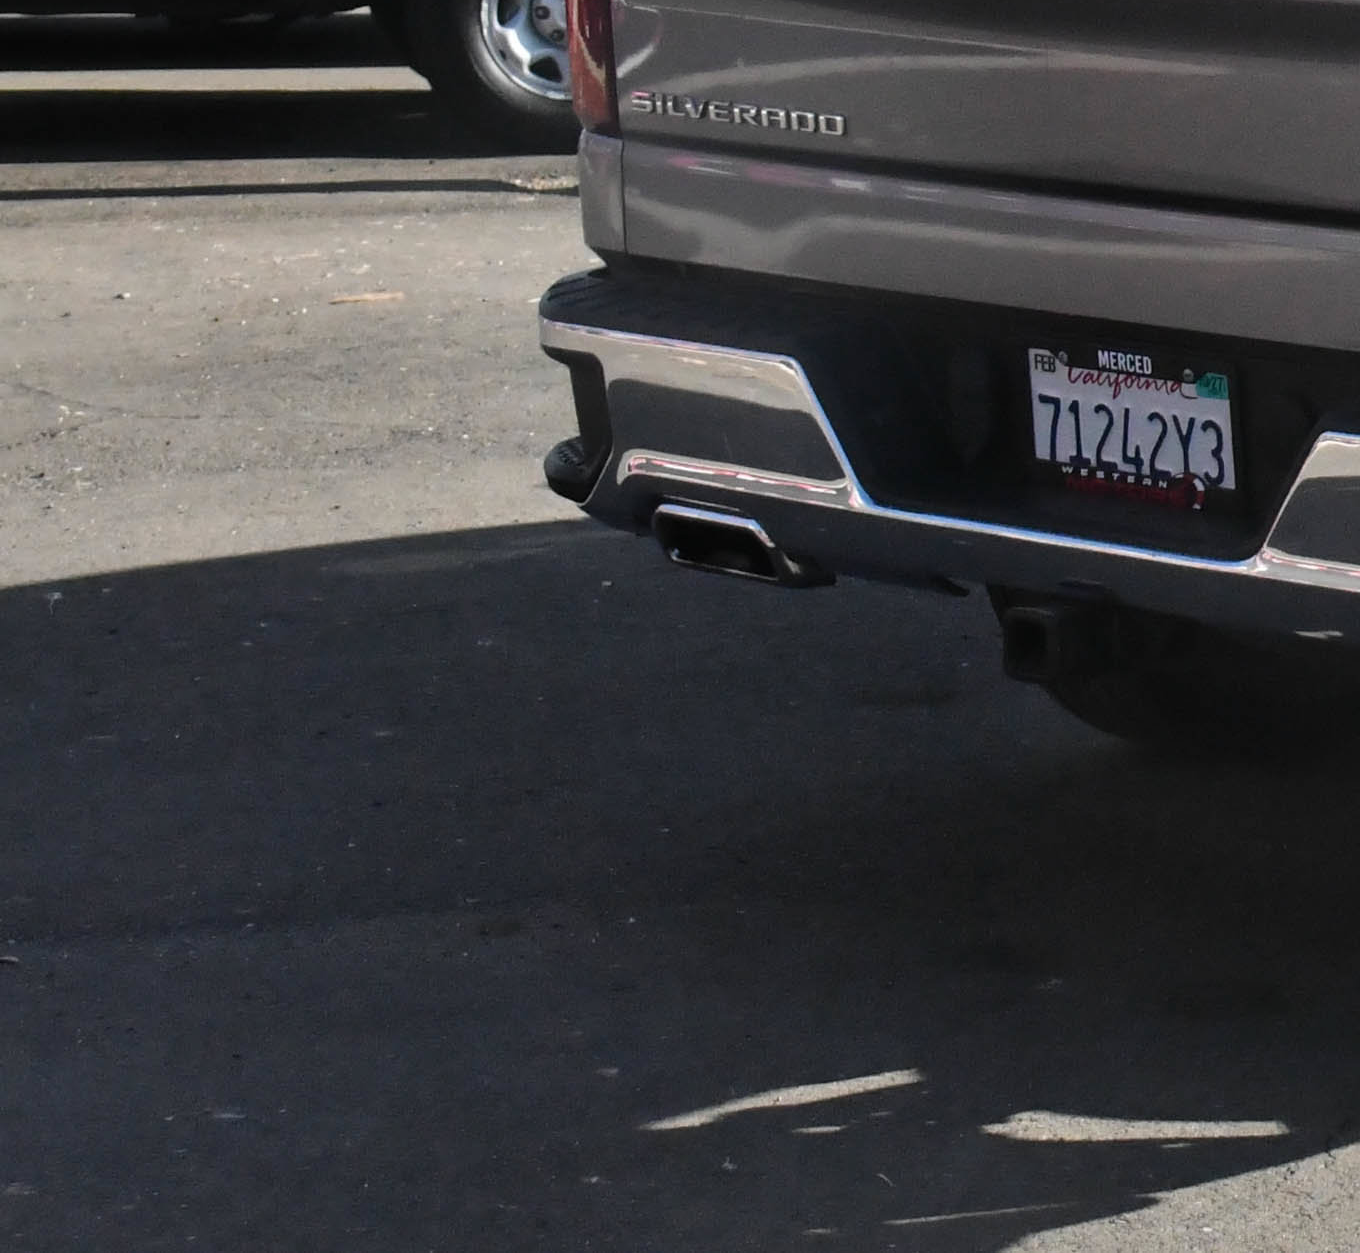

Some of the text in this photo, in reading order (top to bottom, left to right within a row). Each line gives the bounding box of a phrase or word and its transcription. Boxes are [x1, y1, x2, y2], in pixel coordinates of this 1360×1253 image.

[631, 91, 845, 136] SILVERADO
[1034, 353, 1056, 373] FEB
[1098, 349, 1152, 375] MERCED
[1067, 365, 1199, 400] California
[1038, 393, 1225, 486] 71242Y3
[1061, 465, 1168, 489] WESTERN
